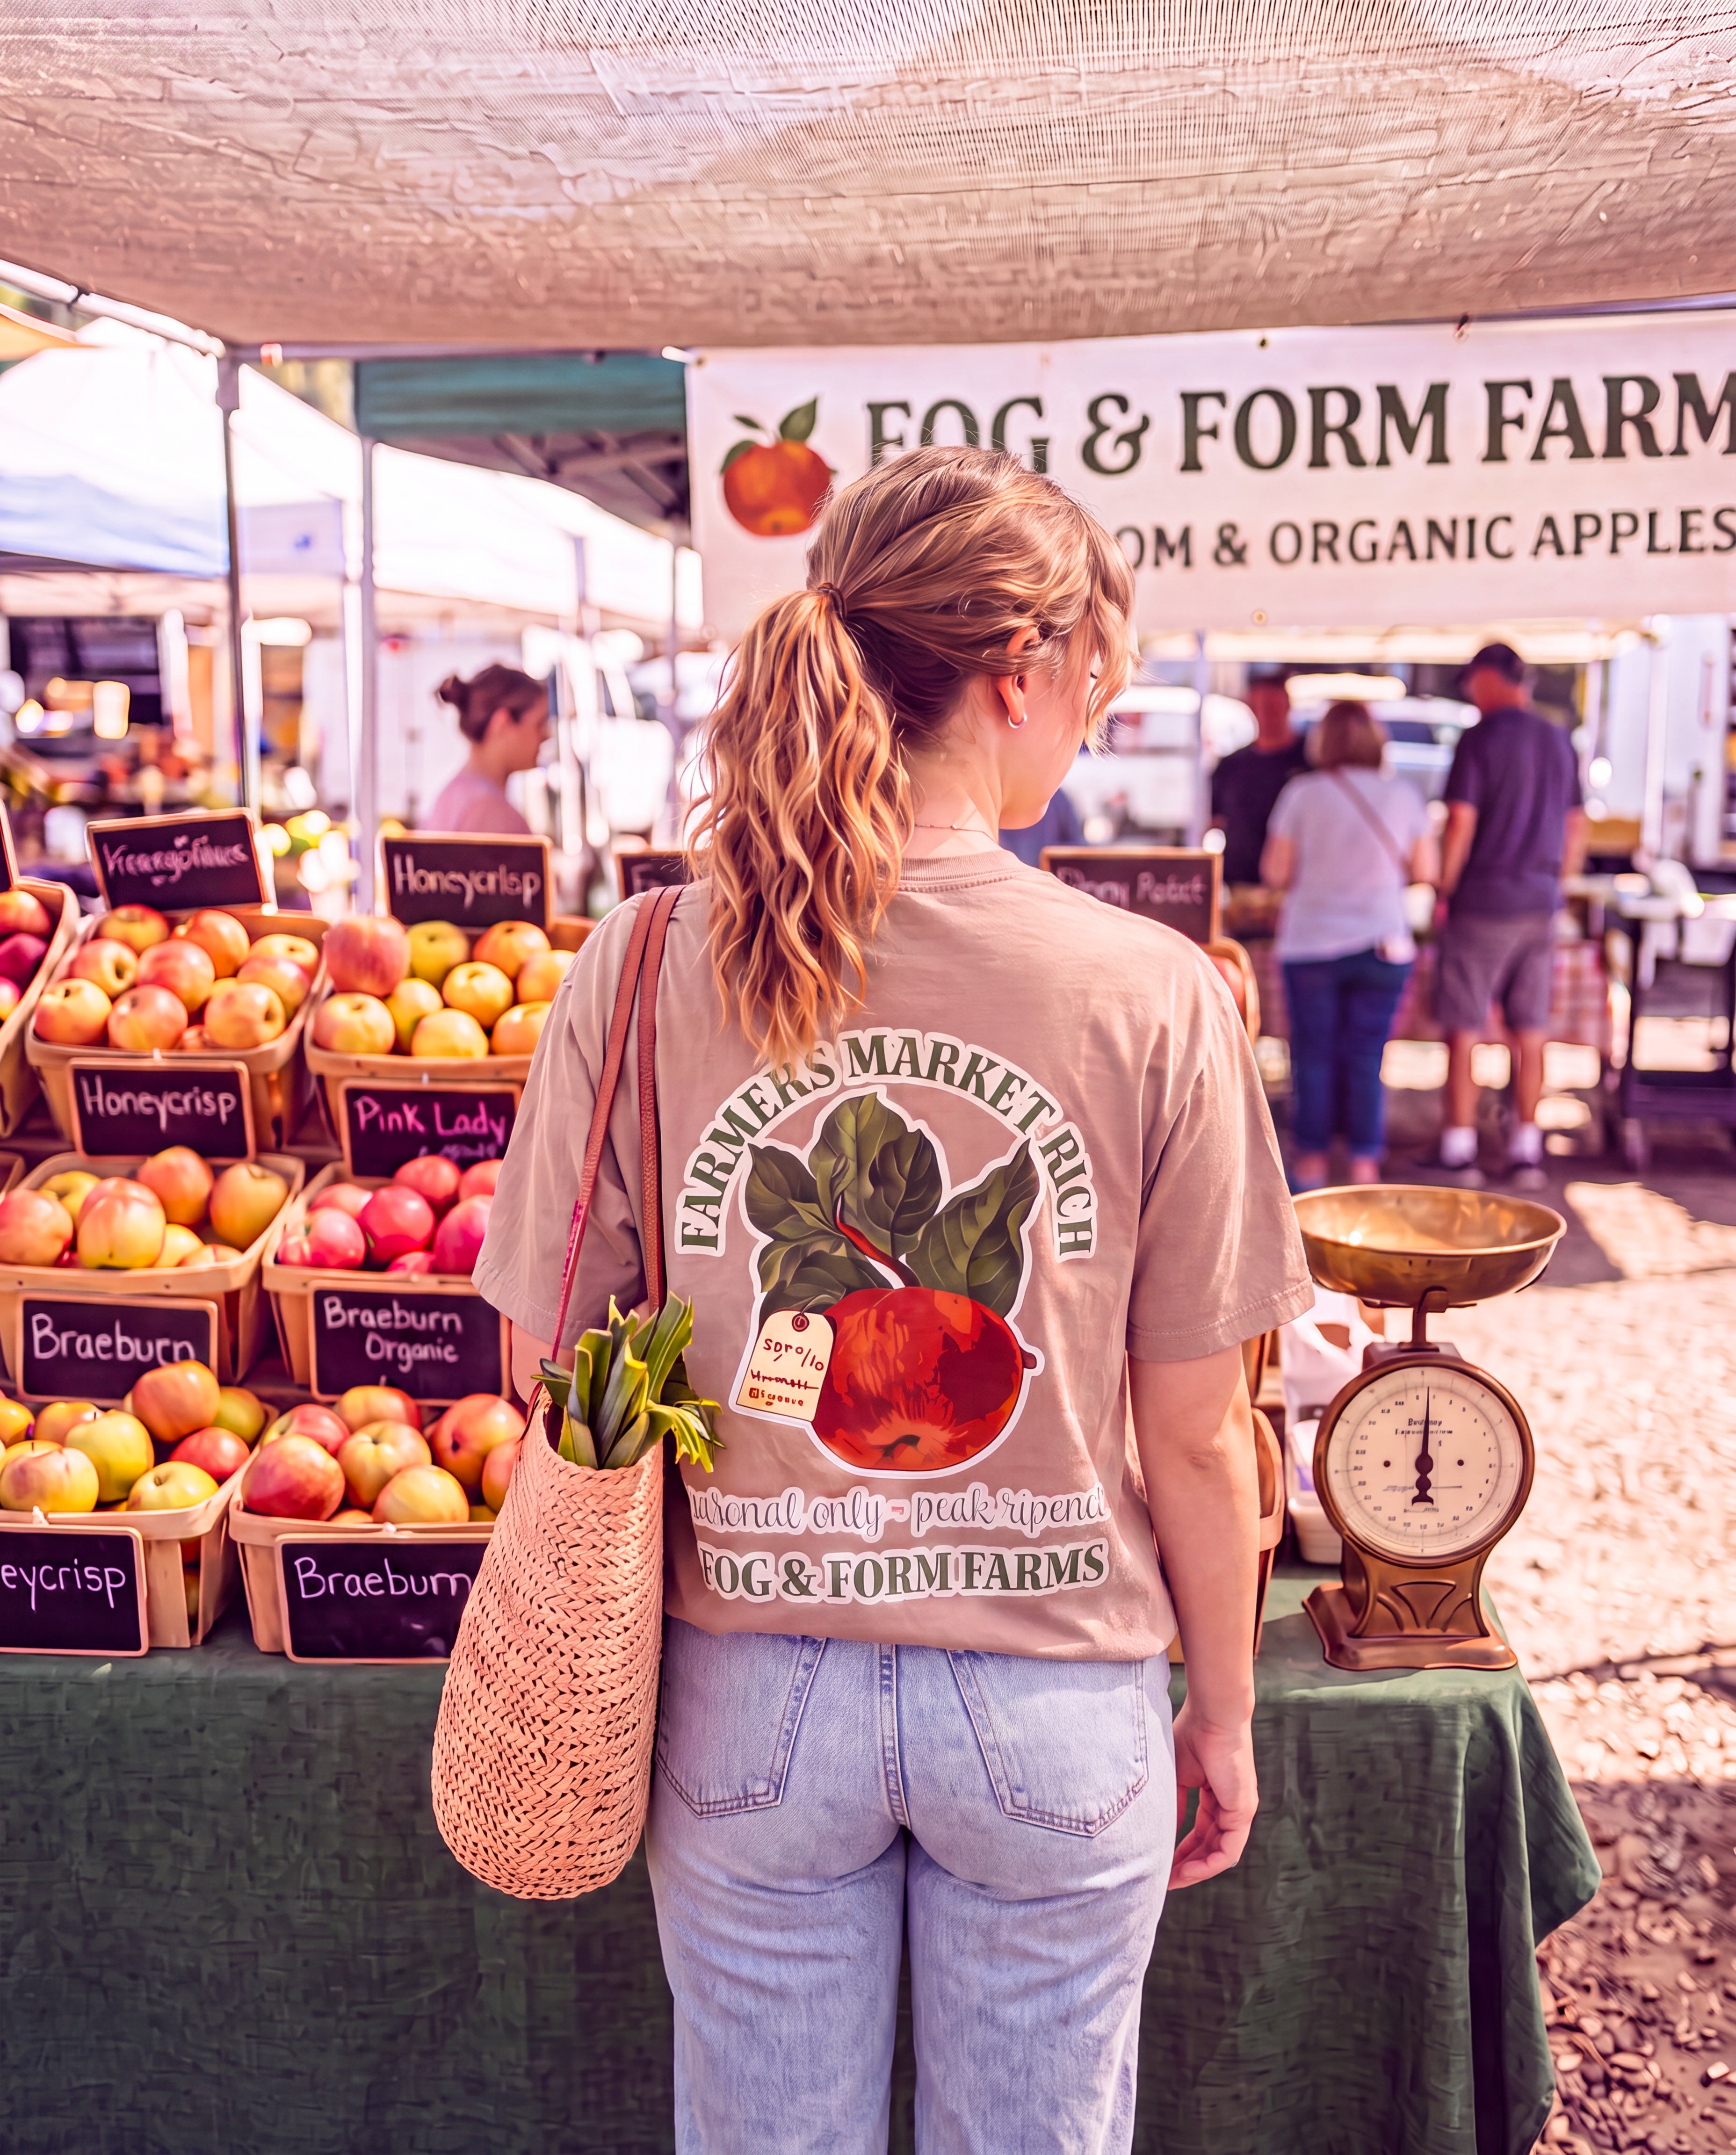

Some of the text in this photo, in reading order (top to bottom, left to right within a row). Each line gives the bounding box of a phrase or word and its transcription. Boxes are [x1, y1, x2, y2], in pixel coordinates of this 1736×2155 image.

[1082, 392, 1150, 474] &
[1180, 383, 1450, 471] FORM
[1482, 371, 1736, 461] FARM
[1214, 521, 1247, 565] &
[1269, 515, 1512, 564] ORGANIC
[1533, 508, 1736, 556] APPLES
[80, 1075, 237, 1133] Honeycrisp
[354, 1095, 506, 1145] Pink Lady
[842, 1034, 1056, 1135] MARKET
[1038, 1128, 1093, 1256] RICH
[32, 1313, 195, 1366] Braeburn
[324, 1296, 463, 1334] Braeburn
[366, 1331, 459, 1373] Organic
[813, 1491, 883, 1537] only
[917, 1488, 995, 1532] peak
[700, 1544, 1104, 1598] FOG & FORM FARMS
